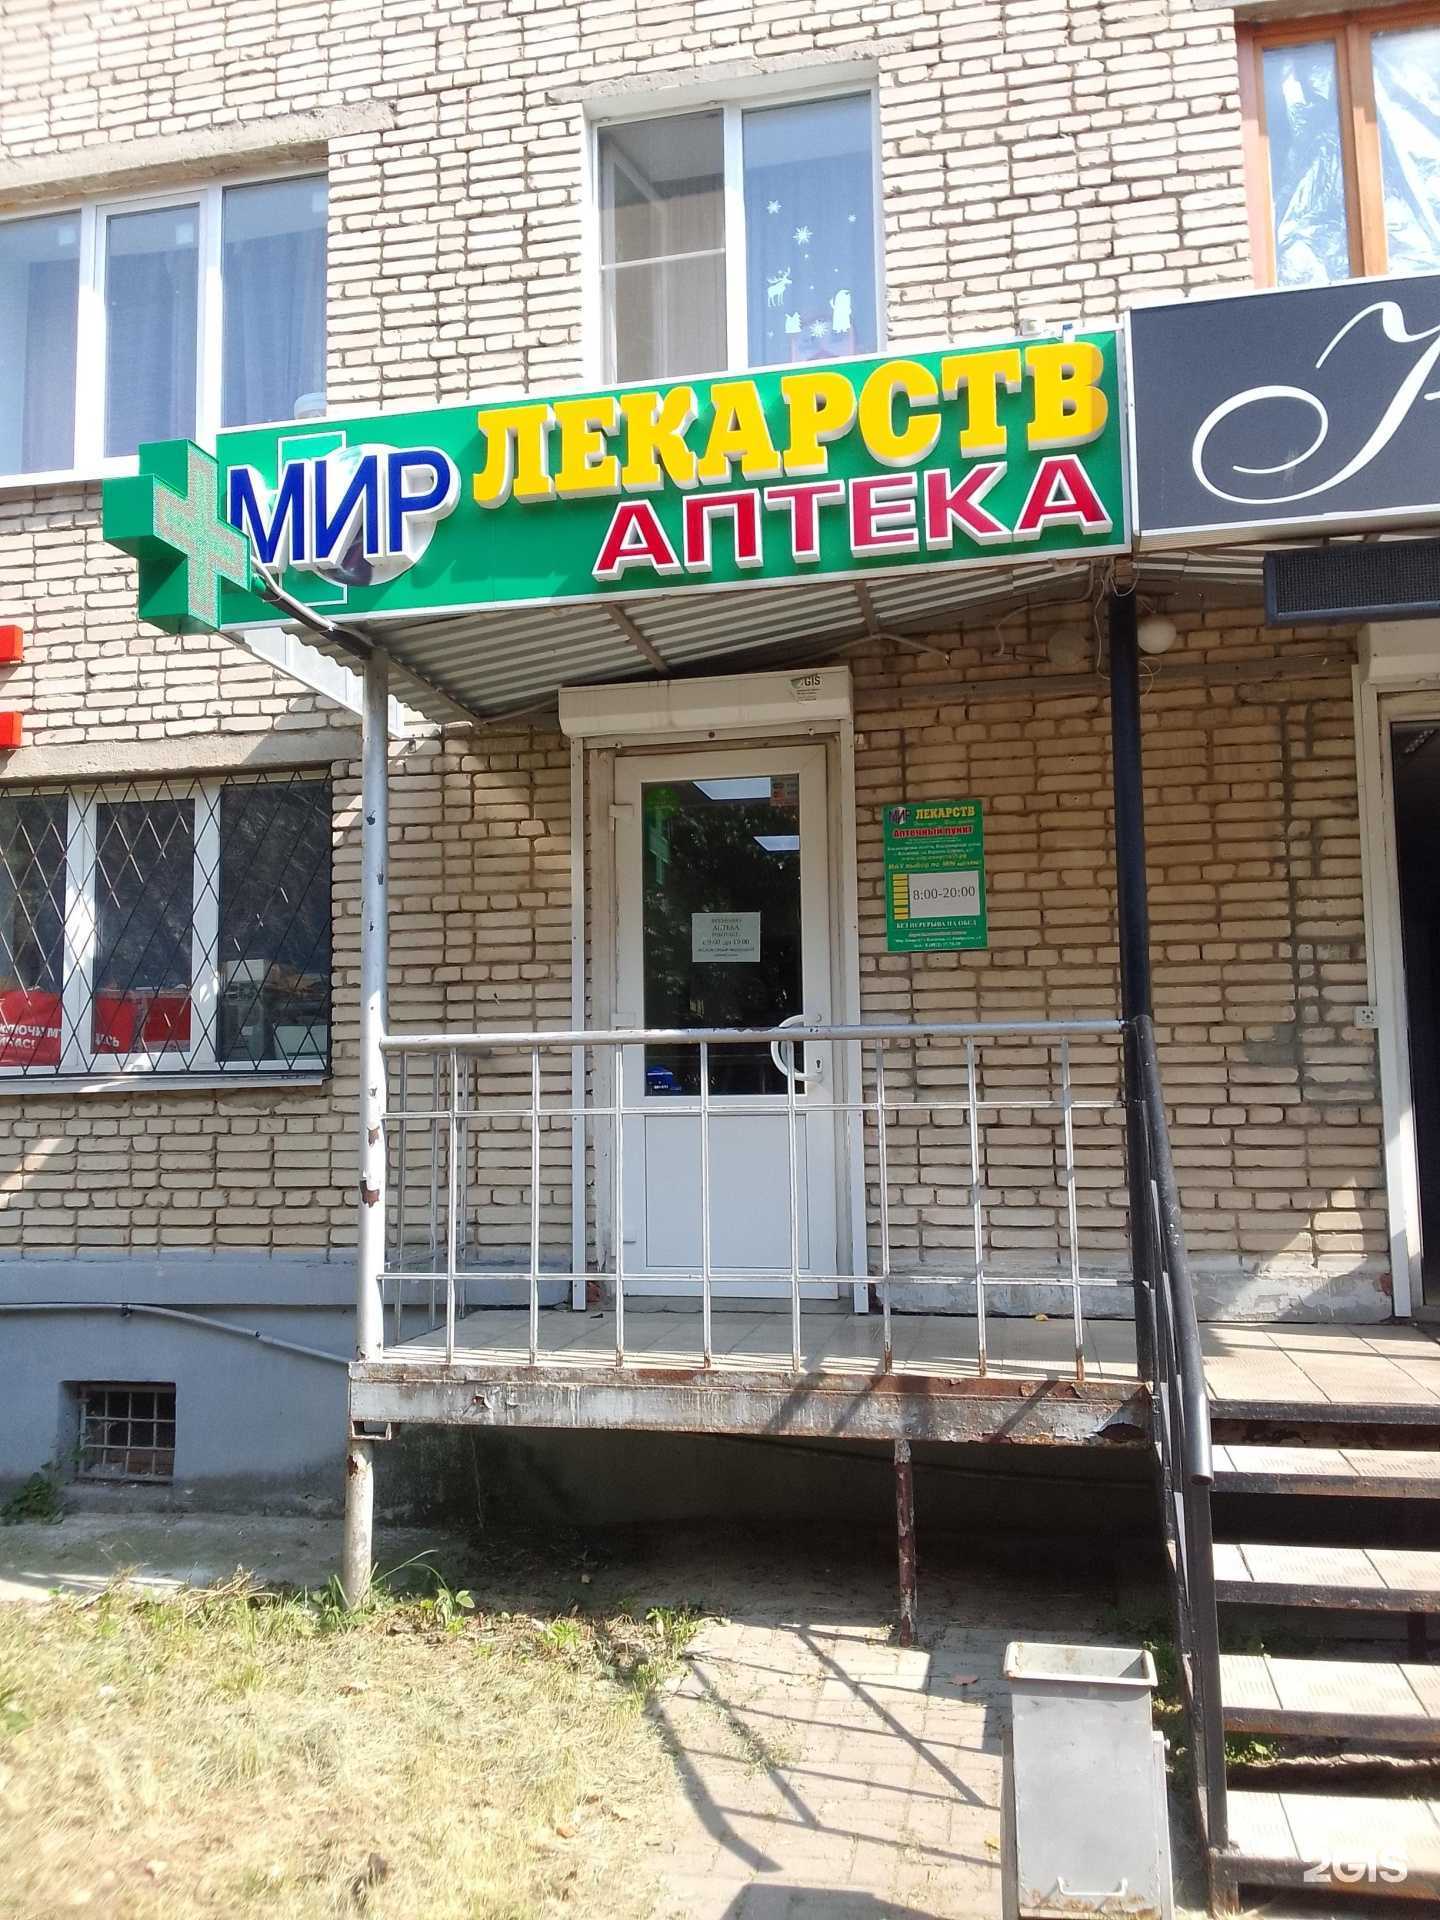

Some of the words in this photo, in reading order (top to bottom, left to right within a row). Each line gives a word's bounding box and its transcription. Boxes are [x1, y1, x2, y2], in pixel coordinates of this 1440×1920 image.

[226, 446, 459, 571] МИР
[473, 341, 1110, 508] ЛЕКАРСТВ
[592, 453, 1114, 581] АПТЕКА
[915, 806, 976, 820] ЛЕКАРСТВ
[912, 885, 976, 901] 8:00-20:00
